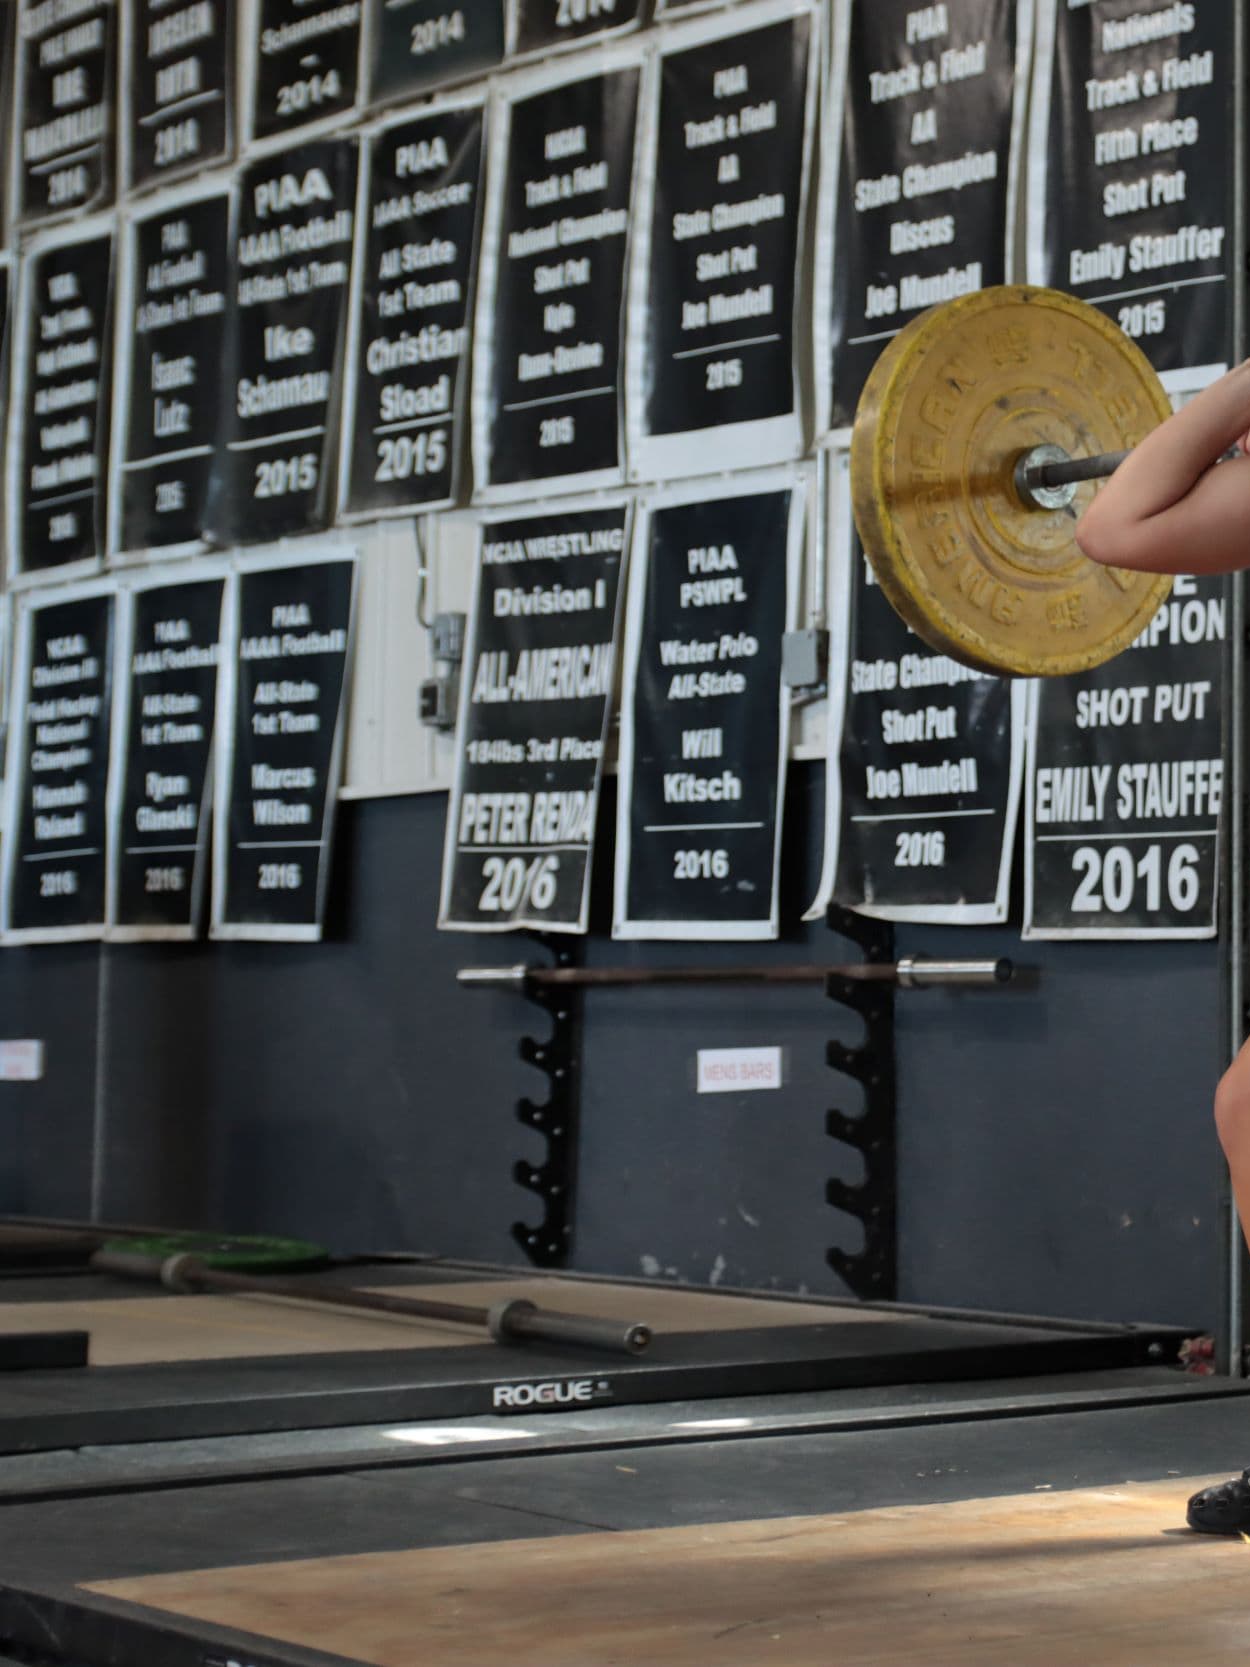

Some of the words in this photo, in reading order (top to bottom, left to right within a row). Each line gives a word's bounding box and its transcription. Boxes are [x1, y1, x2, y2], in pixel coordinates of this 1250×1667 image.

[410, 10, 465, 55] 2014
[906, 3, 949, 44] PIAA
[1102, 1, 1195, 52] Nationals
[869, 63, 920, 103] Track
[922, 60, 938, 89] &
[940, 41, 986, 83] Field
[1086, 70, 1139, 110] Track
[1143, 69, 1158, 93] &
[1161, 51, 1214, 91] Field
[276, 68, 340, 116] 2014
[684, 114, 725, 149] Track
[725, 114, 739, 138] &
[739, 100, 777, 134] Field
[910, 108, 938, 145] AA
[1094, 127, 1140, 165] Fifth
[1141, 116, 1198, 154] Place
[395, 136, 448, 178] PIAA
[254, 167, 333, 218] PIAA
[411, 182, 472, 215] Soccer
[525, 175, 560, 208] Track
[560, 174, 573, 198] &
[573, 161, 608, 195] Field
[855, 174, 900, 211] State
[902, 150, 997, 198] Champion
[1103, 180, 1148, 217] Shot
[1151, 170, 1186, 203] Put
[281, 210, 352, 250] Football
[673, 210, 711, 240] State
[711, 193, 785, 232] Champion
[890, 214, 955, 254] Discus
[401, 238, 457, 273] State
[696, 251, 730, 282] Shot
[730, 244, 757, 273] Put
[1069, 241, 1126, 285] Emily
[1129, 225, 1225, 273] Stauffer
[534, 264, 564, 294] Shot
[563, 258, 590, 288] Put
[866, 285, 897, 319] Joe
[899, 261, 983, 310] Mundell
[378, 290, 405, 318] 1st
[403, 279, 461, 311] Team
[682, 301, 707, 331] Joe
[708, 284, 774, 325] Mundell
[1118, 300, 1165, 339] 2015
[264, 324, 315, 362] Ike
[367, 323, 469, 376] Christian
[706, 359, 743, 391] 2015
[539, 416, 575, 447] 2015
[375, 429, 447, 482] 2015
[254, 453, 318, 498] 2015
[482, 540, 525, 565] NCAA
[525, 528, 623, 561] WRESTLING
[688, 544, 738, 575] PIAA
[493, 584, 593, 617] Division
[680, 577, 747, 608] PSWPL
[272, 603, 310, 628] PIAA
[282, 629, 348, 655] Football
[660, 638, 716, 666] Water
[718, 633, 758, 658] Polo
[253, 680, 320, 705] All-State
[668, 672, 746, 699] All-State
[852, 659, 897, 693] State
[252, 714, 278, 735] 1st
[279, 711, 320, 732] Team
[1076, 686, 1149, 728] SHOT
[1154, 681, 1211, 722] PUT
[163, 722, 203, 743] Team
[682, 727, 722, 760] Will
[882, 709, 925, 744] Shot
[925, 706, 957, 739] Put
[526, 738, 558, 762] 3rd
[560, 736, 602, 760] Place
[145, 772, 190, 802] Ryan
[252, 763, 316, 790] Marcus
[664, 770, 741, 803] Kitsch
[866, 765, 900, 799] Joe
[902, 758, 977, 796] Mundell
[1036, 765, 1112, 823] EMILY
[1116, 759, 1224, 819] STAUFFE
[253, 799, 311, 826] Wilson
[459, 792, 529, 844] PETER
[530, 791, 594, 843] RENDA
[674, 850, 729, 880] 2016
[894, 831, 945, 867] 2016
[145, 866, 185, 892] 2016
[258, 863, 301, 890] 2016
[478, 853, 561, 912] 2016
[1071, 844, 1199, 912] 2016
[493, 1380, 593, 1407] ROGUE
